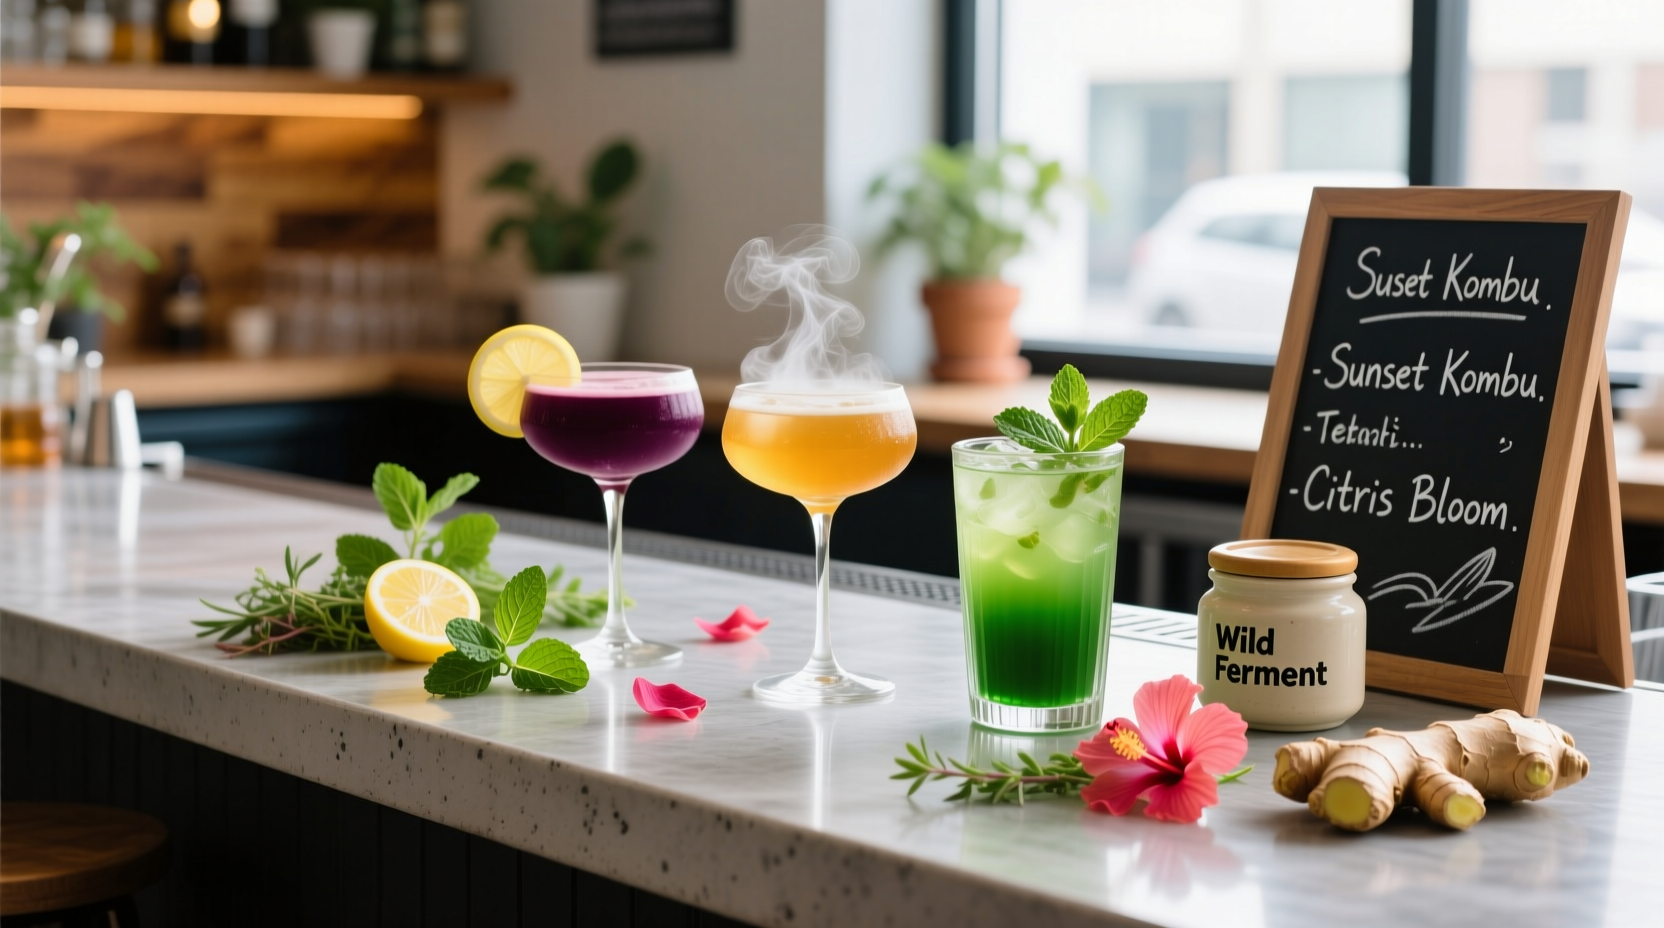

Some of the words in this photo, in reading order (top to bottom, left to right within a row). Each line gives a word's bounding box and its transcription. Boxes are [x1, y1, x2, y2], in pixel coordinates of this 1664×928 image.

[1346, 246, 1434, 300] Suset
[1439, 348, 1545, 403] Kombu.
[1408, 473, 1519, 532] Bloom.
[1215, 622, 1275, 656] Wild
[1215, 653, 1328, 688] Ferment
